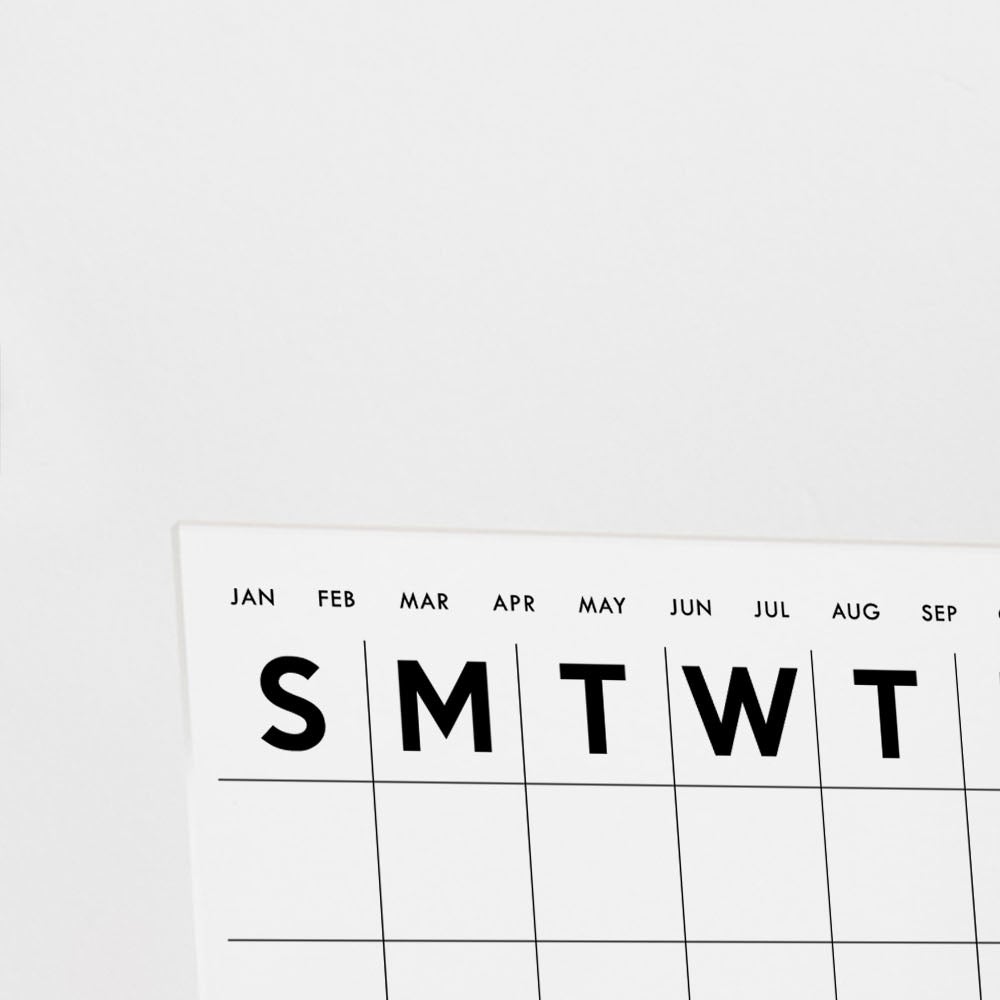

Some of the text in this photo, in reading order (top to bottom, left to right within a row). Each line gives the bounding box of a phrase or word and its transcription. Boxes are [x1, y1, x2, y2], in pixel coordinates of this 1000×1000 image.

[230, 587, 275, 606] JAN
[317, 590, 356, 608] FEB
[399, 591, 449, 610] MAR
[492, 594, 535, 613] APR
[578, 596, 626, 614] MAY
[669, 598, 712, 617] JUN
[754, 600, 790, 619] JUL
[831, 602, 881, 620] AUG
[921, 604, 958, 622] SEP
[259, 655, 327, 752] S
[396, 659, 493, 753] M
[558, 662, 627, 755] T
[681, 665, 798, 758] W
[852, 668, 918, 759] T
